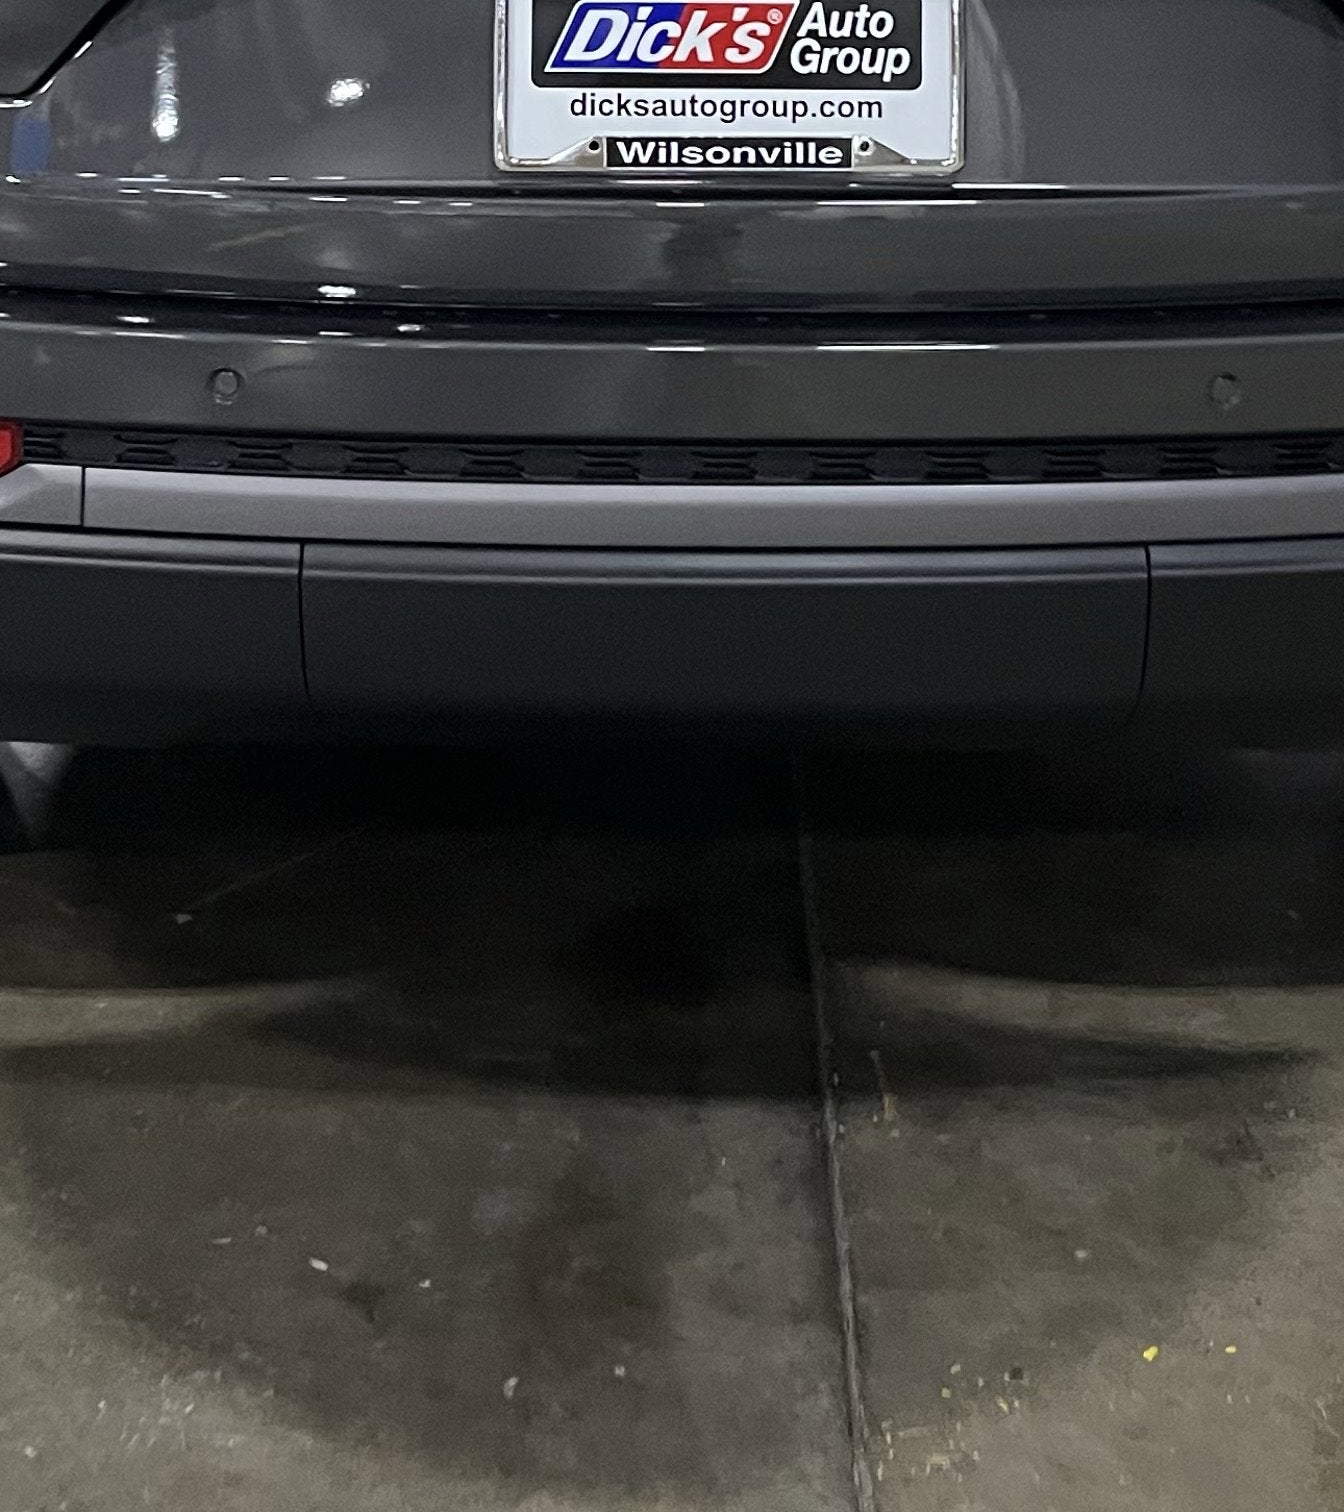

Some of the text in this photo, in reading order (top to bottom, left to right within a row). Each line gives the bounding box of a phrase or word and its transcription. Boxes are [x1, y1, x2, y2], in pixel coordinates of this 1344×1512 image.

[563, 6, 771, 64] Dick's
[797, 1, 895, 39] Auto
[790, 39, 911, 82] Group
[570, 92, 883, 124] dicksautogroup.com
[615, 140, 843, 165] Wilsonville
